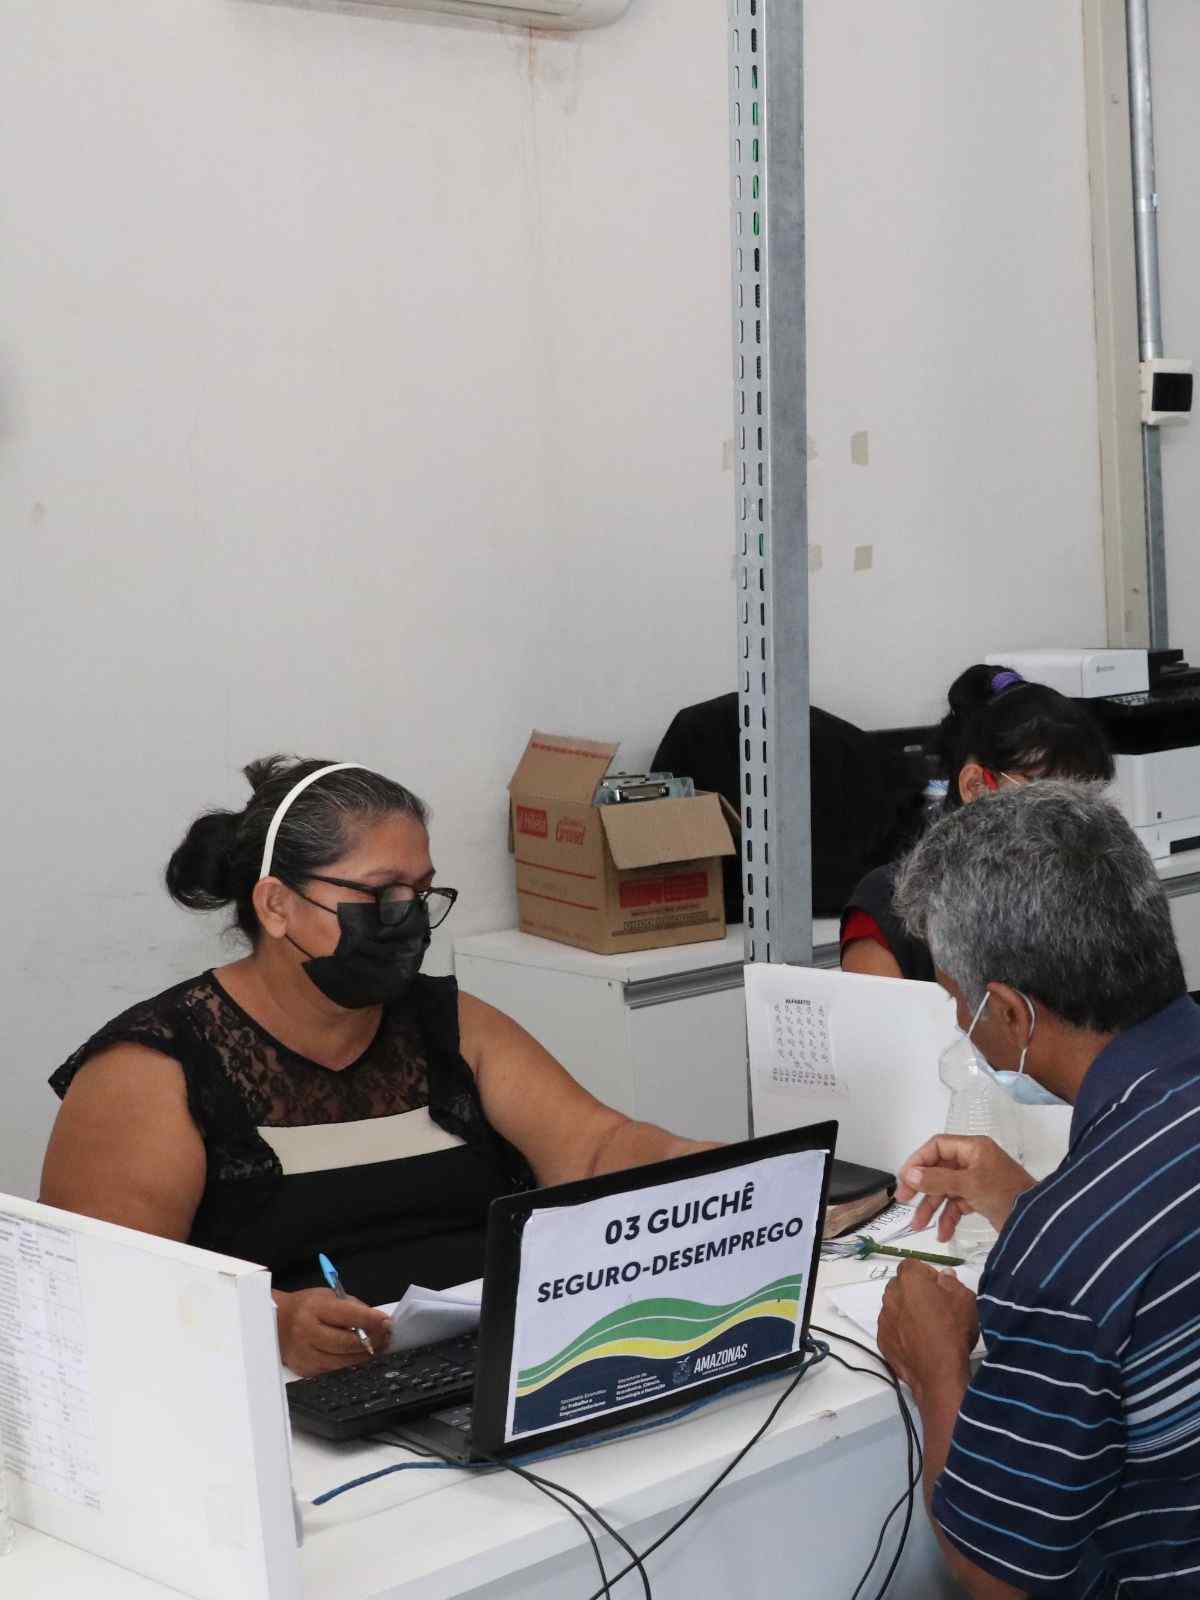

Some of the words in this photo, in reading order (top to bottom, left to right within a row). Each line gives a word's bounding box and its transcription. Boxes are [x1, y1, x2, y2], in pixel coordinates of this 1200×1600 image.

[604, 1214, 641, 1245] 03
[646, 1181, 755, 1234] GUICHÊ
[536, 1216, 804, 1303] SEGURO-DESEMPREGO
[693, 1343, 749, 1374] AMAZONAS
